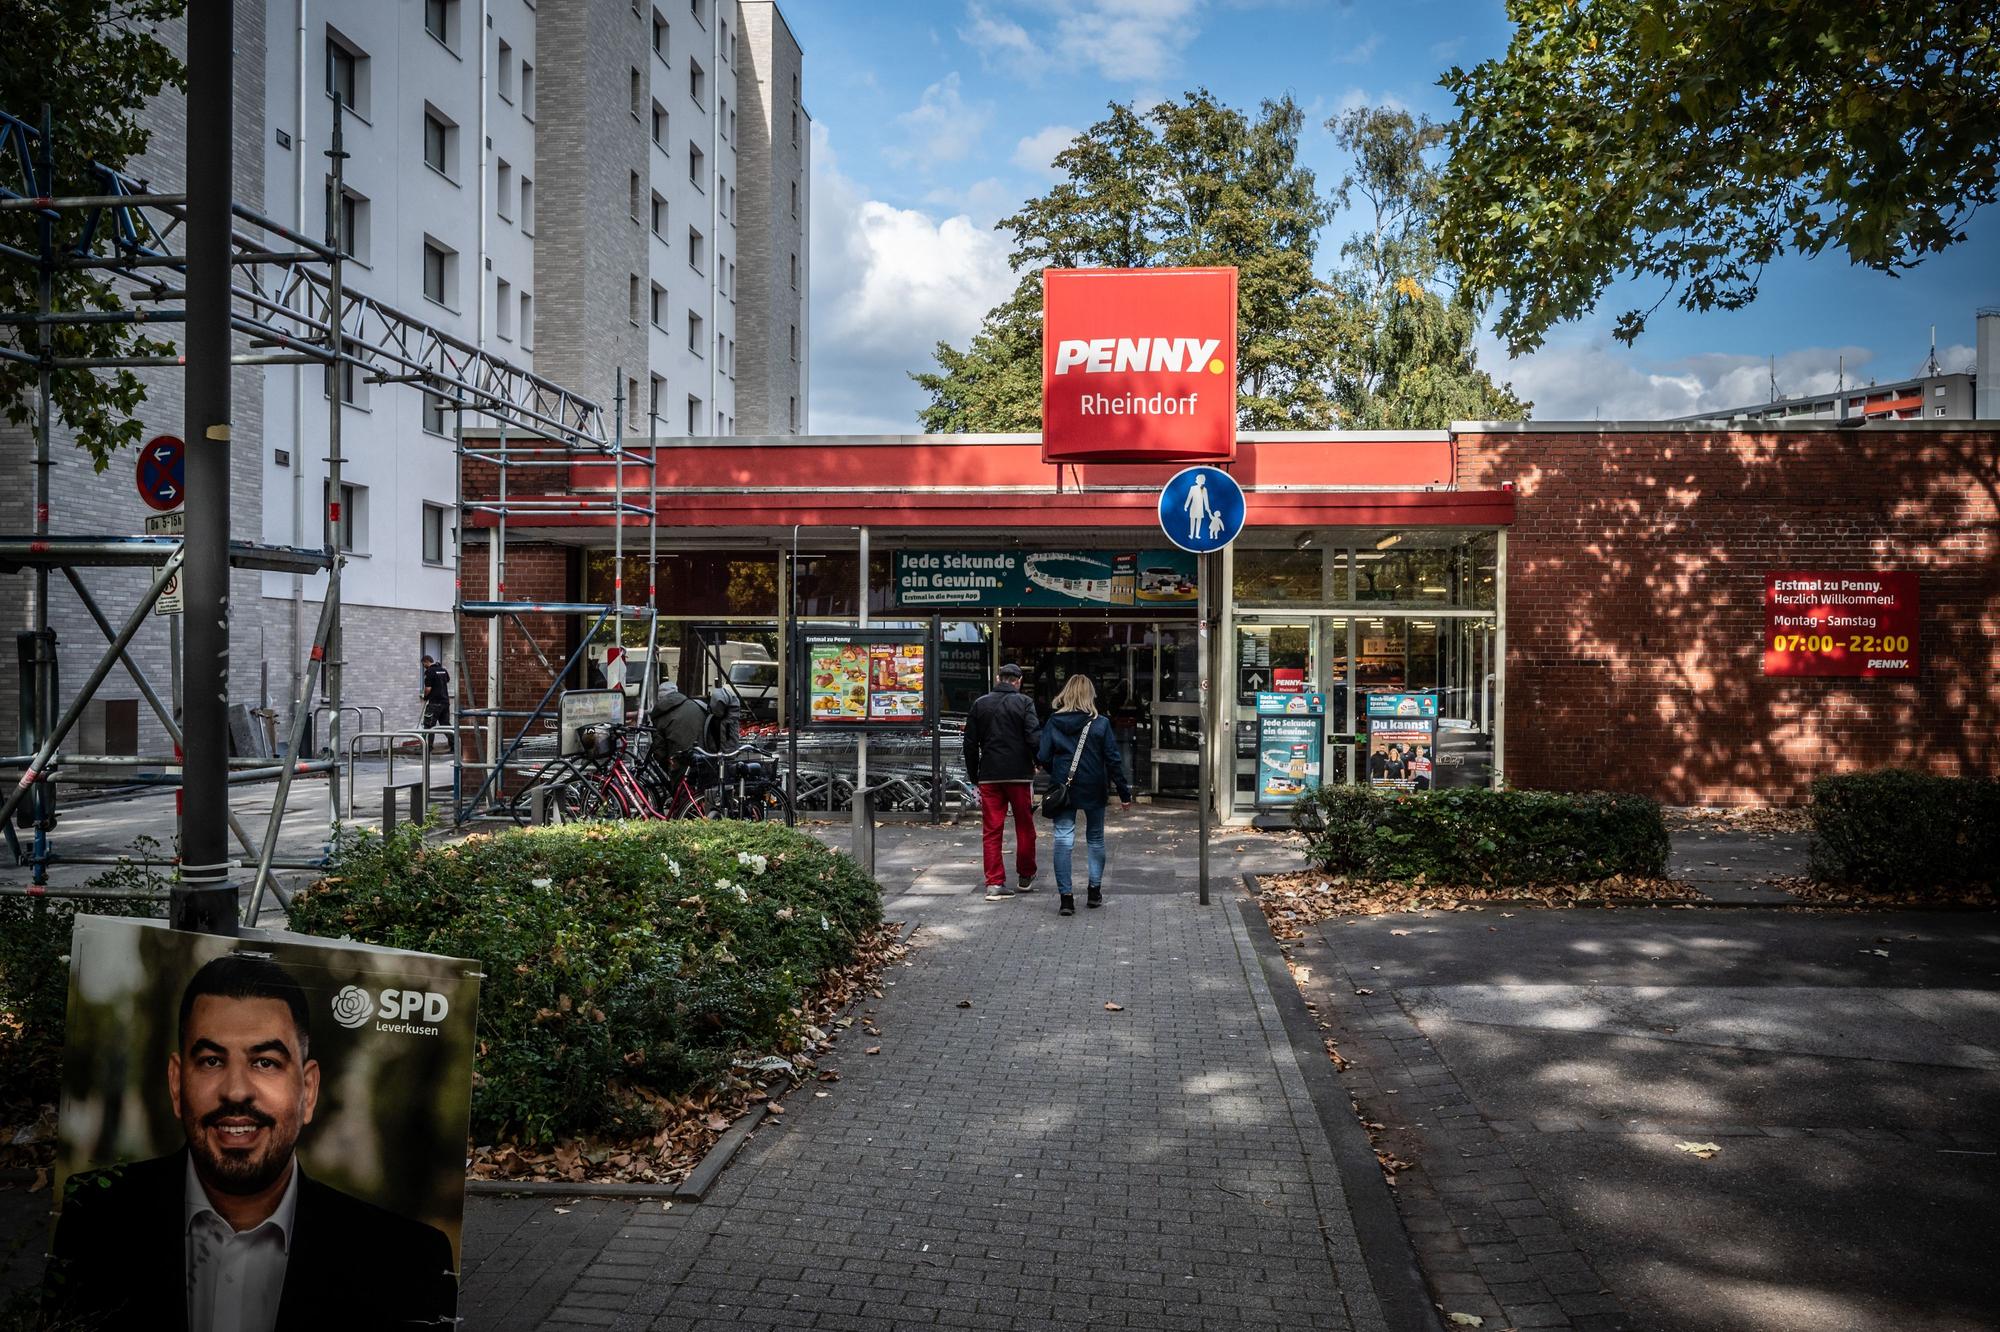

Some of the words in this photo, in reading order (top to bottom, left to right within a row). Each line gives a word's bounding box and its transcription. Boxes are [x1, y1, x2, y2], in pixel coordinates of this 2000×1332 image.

[1055, 338, 1225, 375] PENNY.
[1081, 392, 1198, 415] Rheindorf
[901, 554, 940, 569] Jede
[943, 554, 1015, 569] Sekunde
[901, 571, 928, 587] ein
[932, 571, 1003, 588] Gewinn.
[1774, 580, 1821, 591] Erstmal
[1824, 582, 1838, 591] zu
[1841, 580, 1882, 593] Penny.
[1774, 594, 1818, 605] Herzlich
[1820, 594, 1894, 605] Willkommen!
[1827, 615, 1876, 629] Samstag
[1774, 635, 1834, 652] 07:00
[1849, 635, 1909, 653] 22:00
[1866, 660, 1909, 669] PENNY.
[1372, 720, 1388, 730] Du
[1390, 720, 1429, 730] kannst
[378, 988, 449, 1023] SPD
[376, 1021, 438, 1036] Leverkusen
